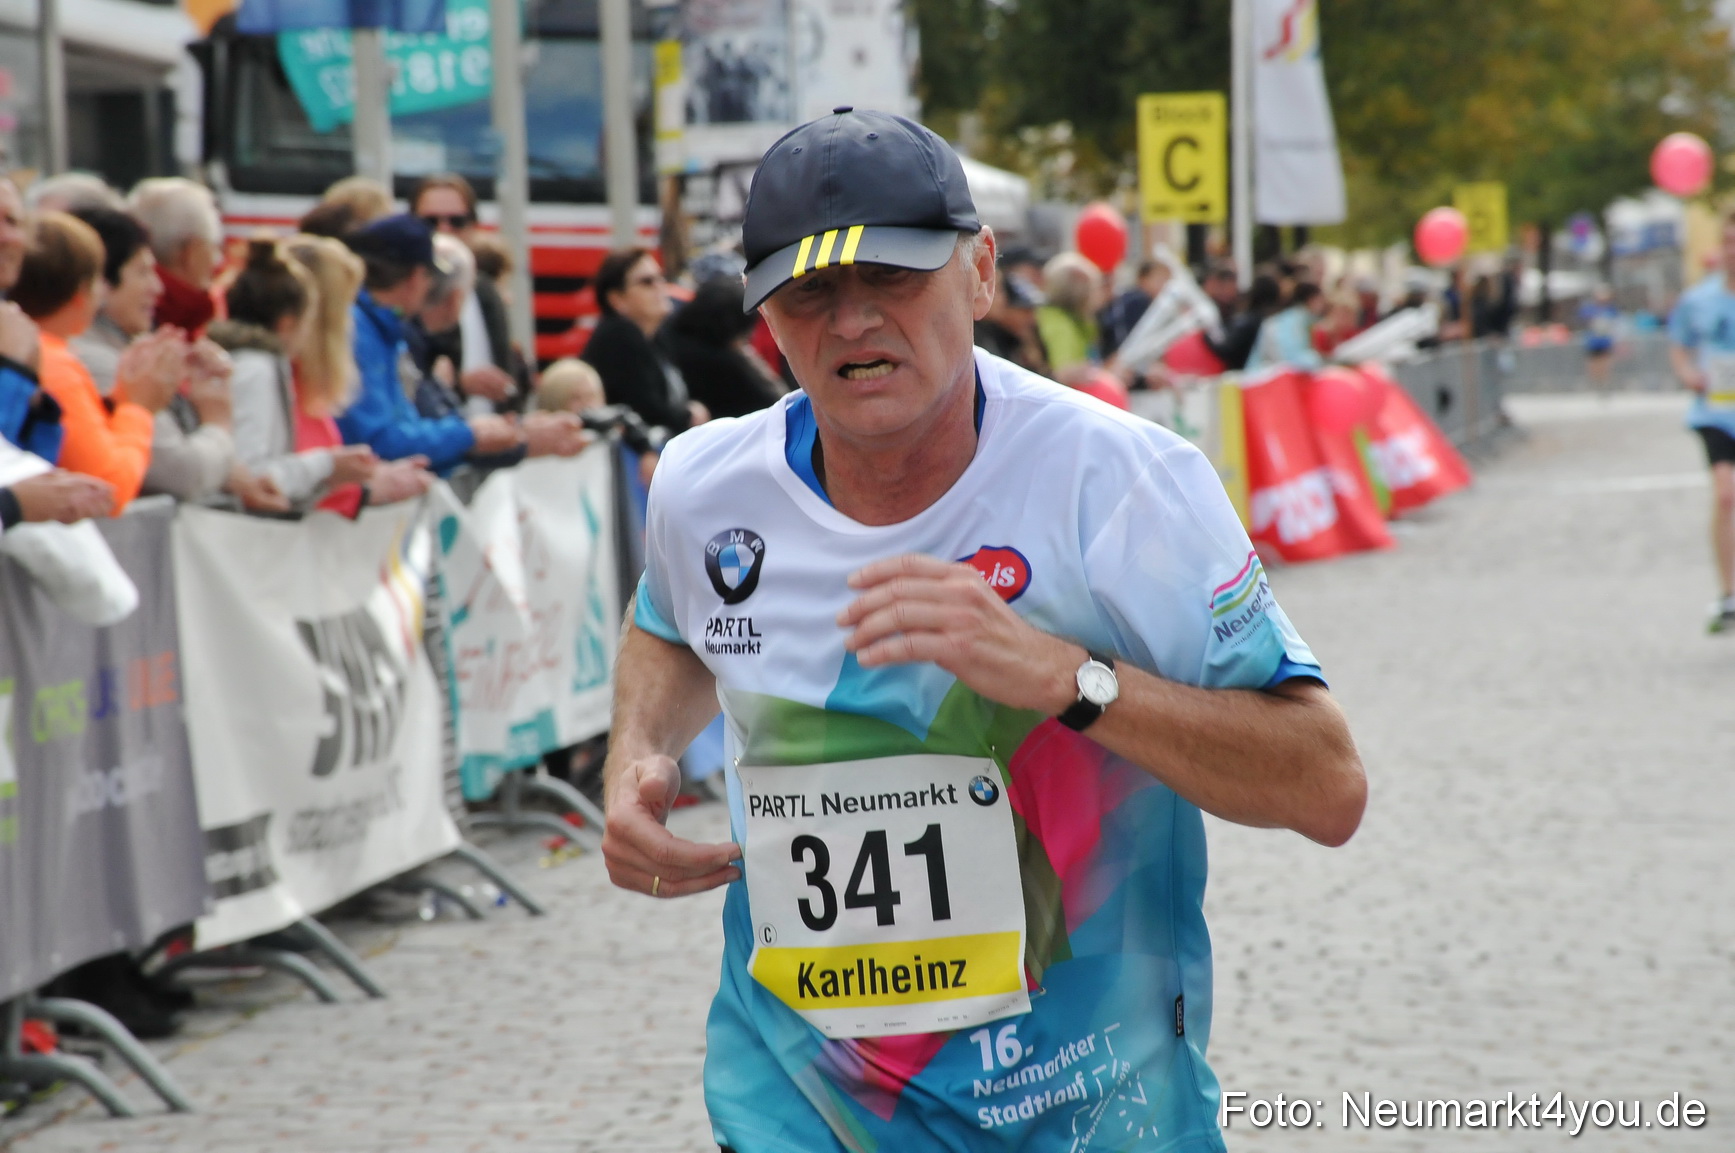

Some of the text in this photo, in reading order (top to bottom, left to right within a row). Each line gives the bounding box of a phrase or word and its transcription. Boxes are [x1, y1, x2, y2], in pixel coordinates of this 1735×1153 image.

[1163, 136, 1201, 193] C
[704, 639, 762, 655] Neumarkt
[705, 617, 762, 637] PARTL
[749, 783, 958, 818] PARTL Neumarkt
[790, 823, 951, 932] 341
[797, 954, 967, 998] Karlheinz
[969, 1023, 1034, 1072] 16.
[973, 1032, 1096, 1099] Neumarkter
[977, 1070, 1088, 1130] Stadtlauf
